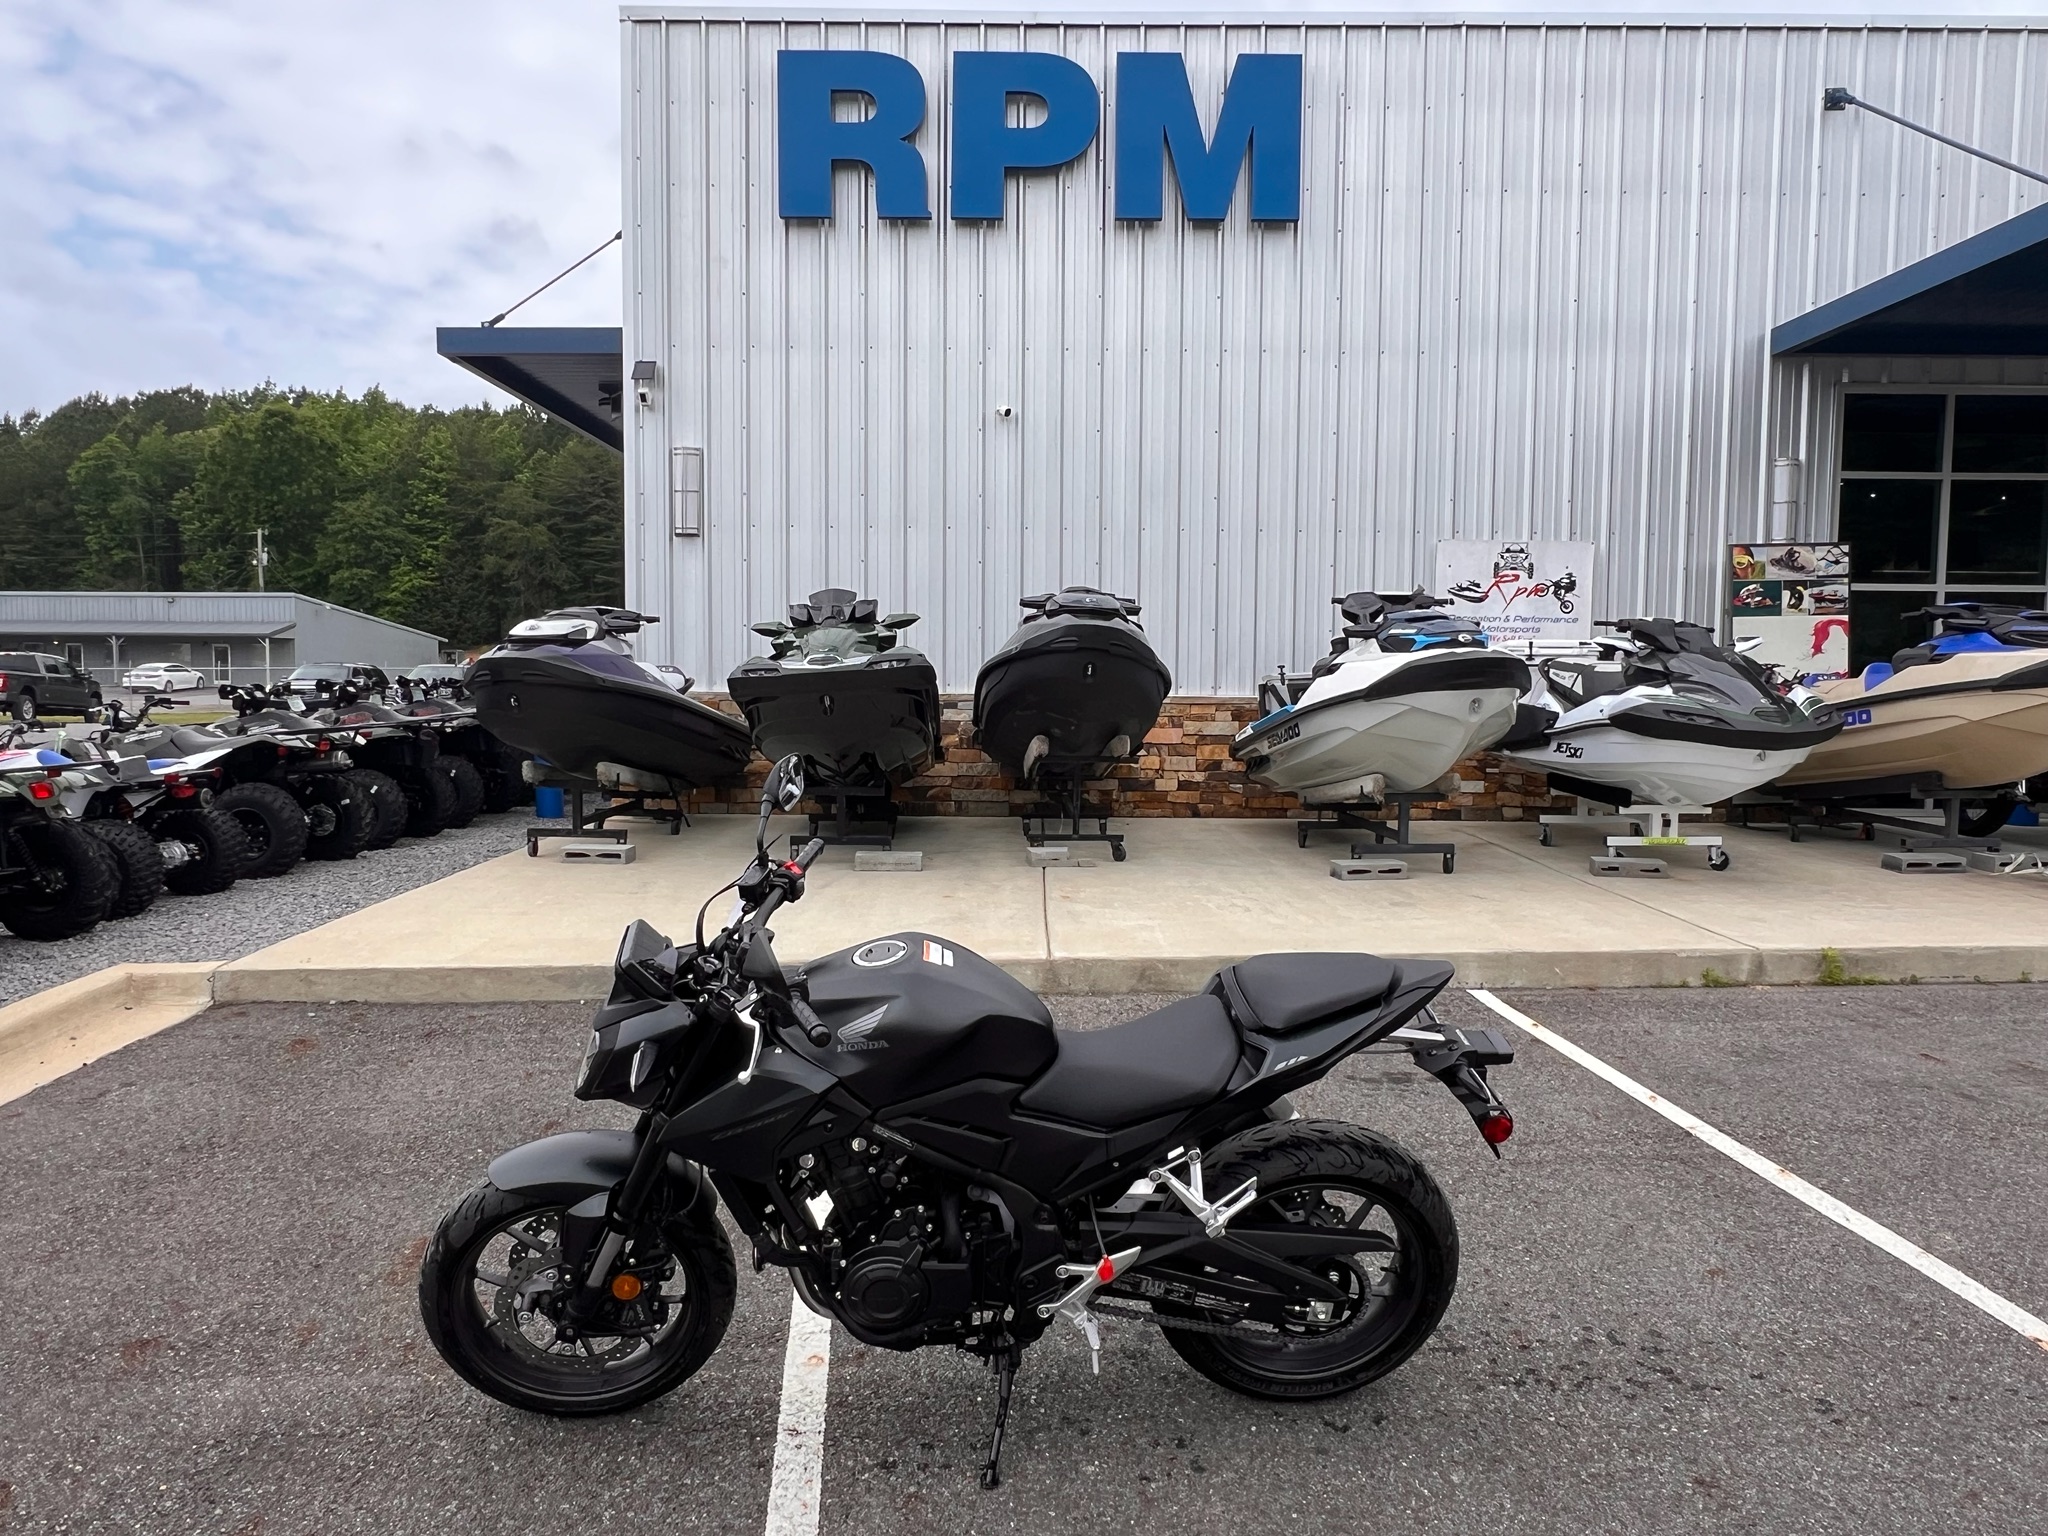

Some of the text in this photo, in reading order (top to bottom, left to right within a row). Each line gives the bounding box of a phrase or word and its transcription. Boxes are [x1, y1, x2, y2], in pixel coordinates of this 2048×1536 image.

[777, 50, 1302, 222] RPM
[1503, 614, 1510, 623] &
[1512, 614, 1579, 624] Performance
[1553, 741, 1572, 754] JET
[837, 1040, 890, 1053] HONDA
